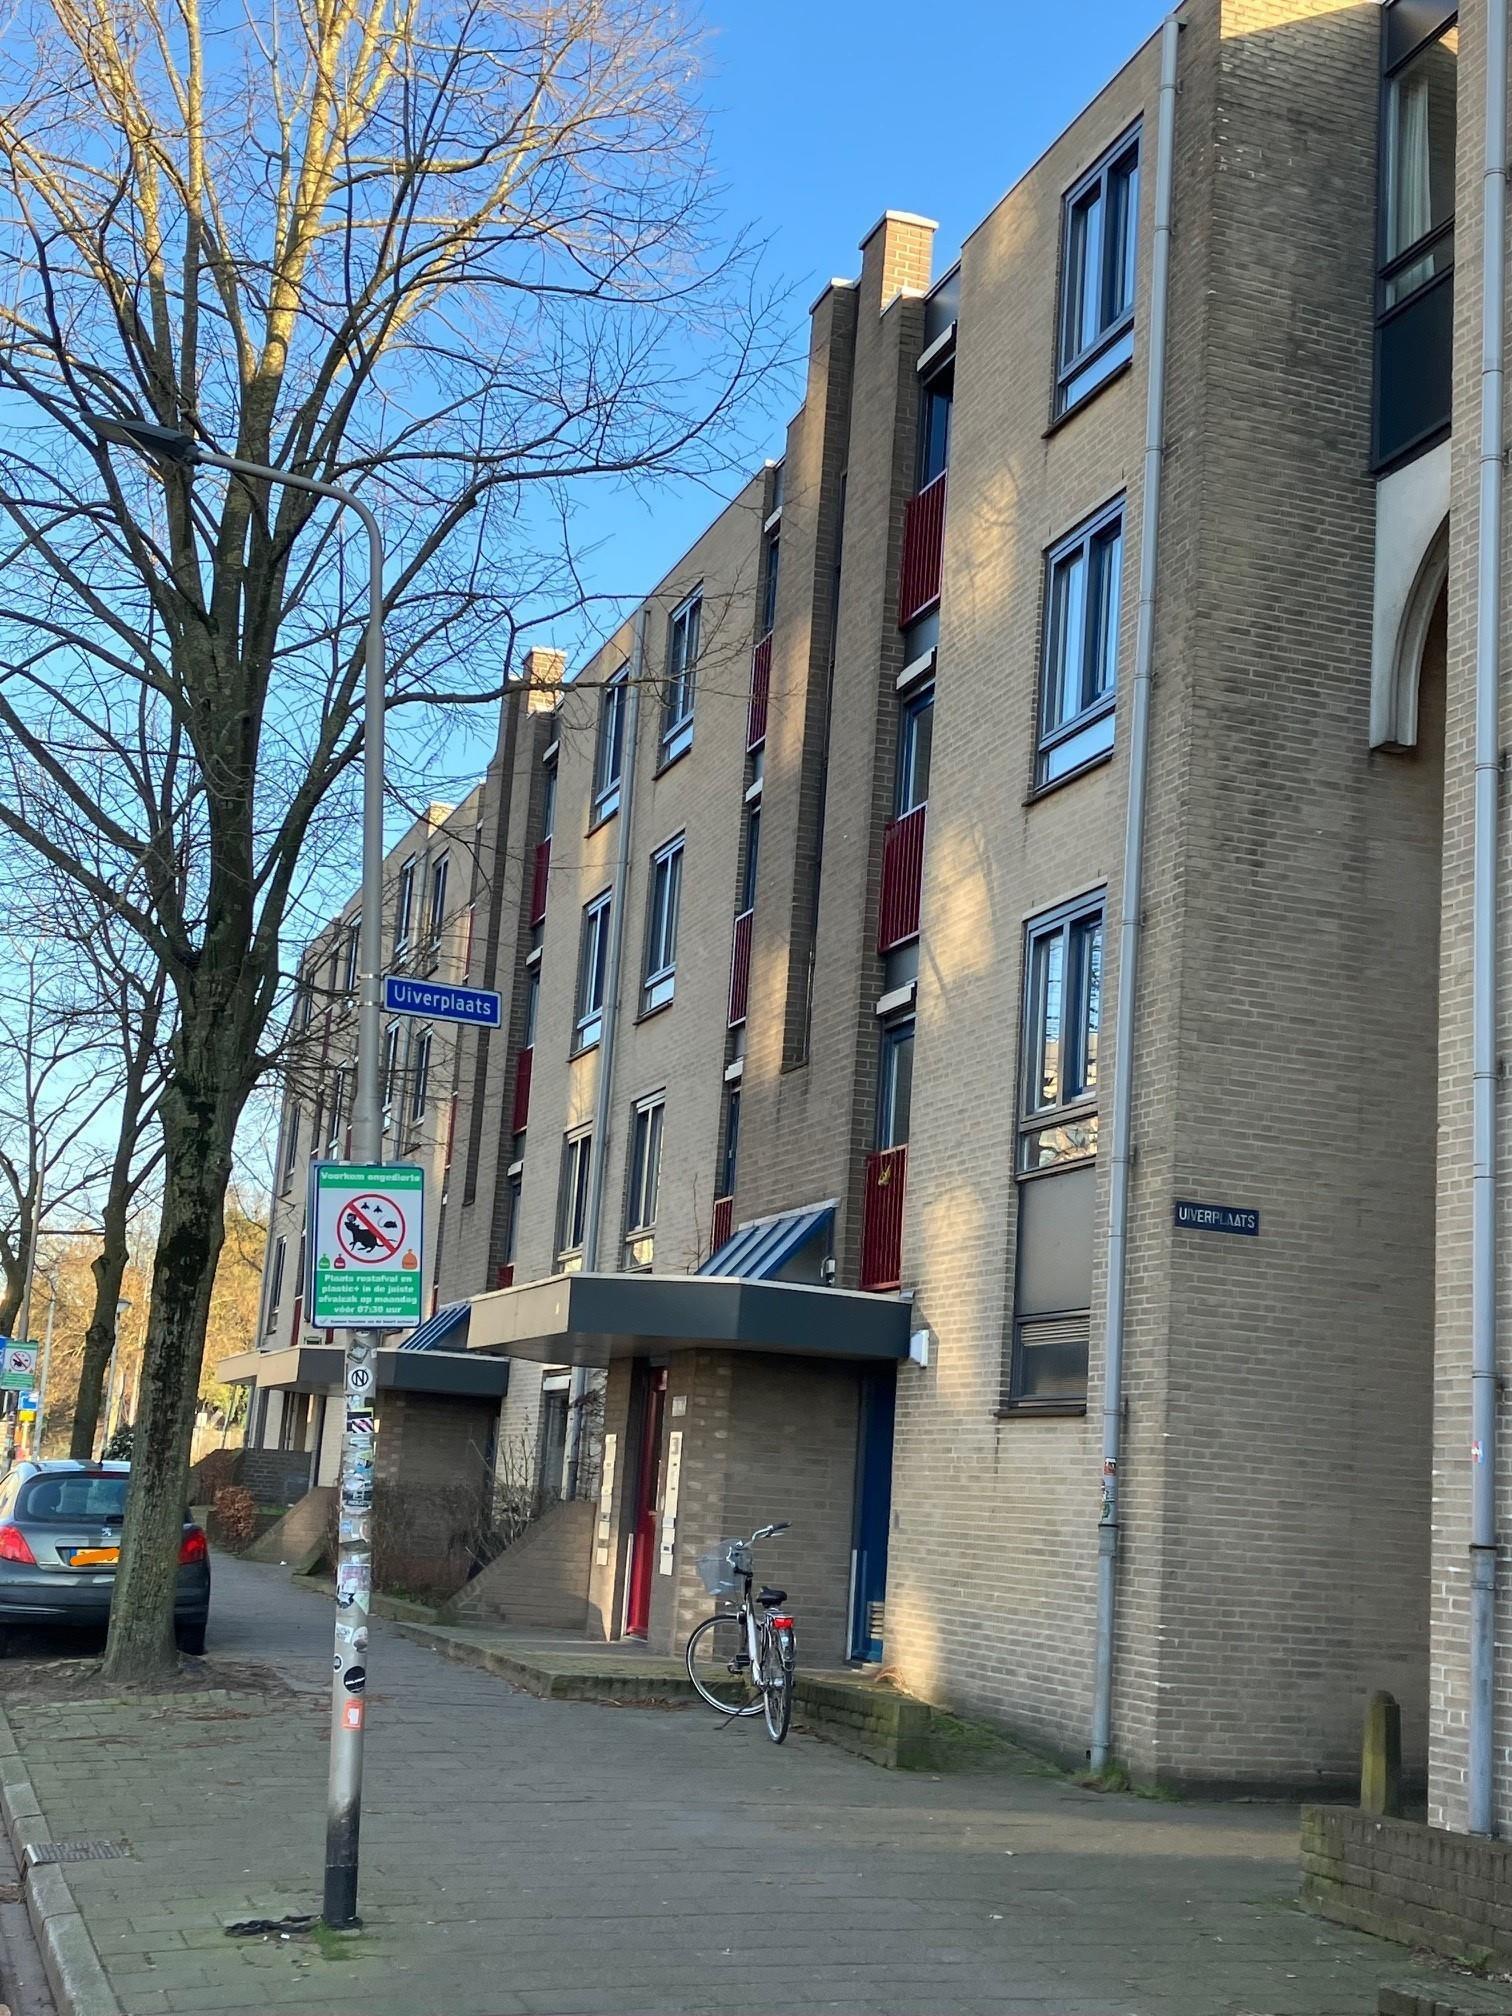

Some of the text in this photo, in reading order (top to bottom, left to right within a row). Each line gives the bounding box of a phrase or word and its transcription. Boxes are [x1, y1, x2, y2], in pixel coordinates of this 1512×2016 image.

[394, 985, 491, 1015] Uiverplaats
[321, 1172, 421, 1182] Voorkom ongedierte
[324, 1274, 354, 1283] Plaats
[356, 1275, 398, 1283] restafval
[322, 1284, 414, 1295] plastic+ in de juiste
[318, 1295, 358, 1303] afvalzak
[374, 1296, 418, 1305] maandag
